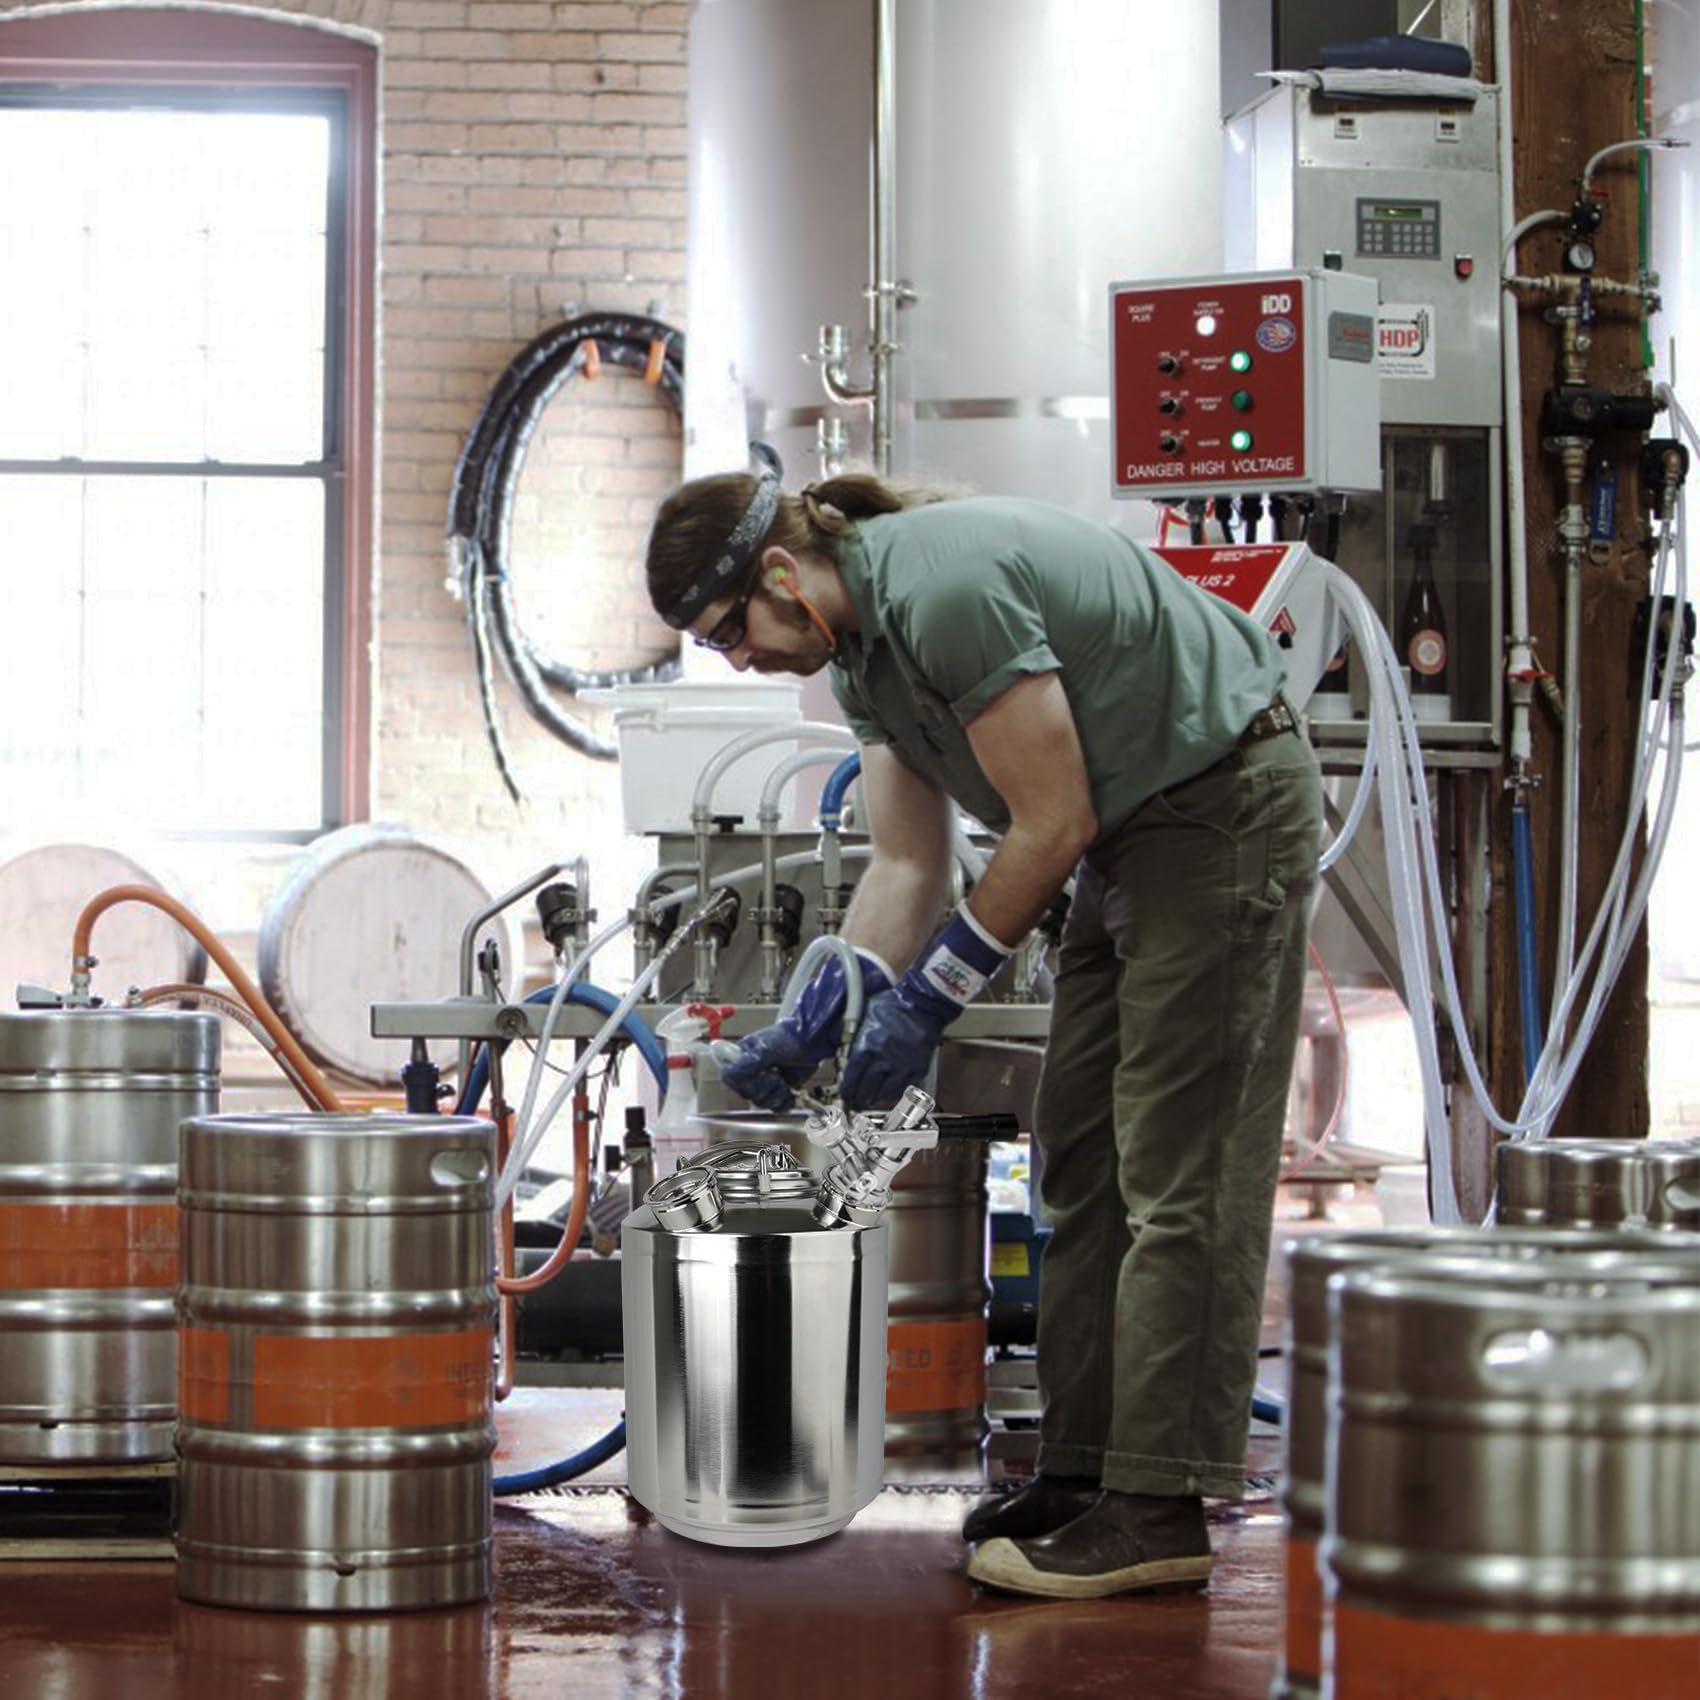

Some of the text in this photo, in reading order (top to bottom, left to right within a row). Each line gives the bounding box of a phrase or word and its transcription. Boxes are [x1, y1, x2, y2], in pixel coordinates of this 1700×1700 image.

[1127, 456, 1295, 479] DANGER HIGH VOLTAGE
